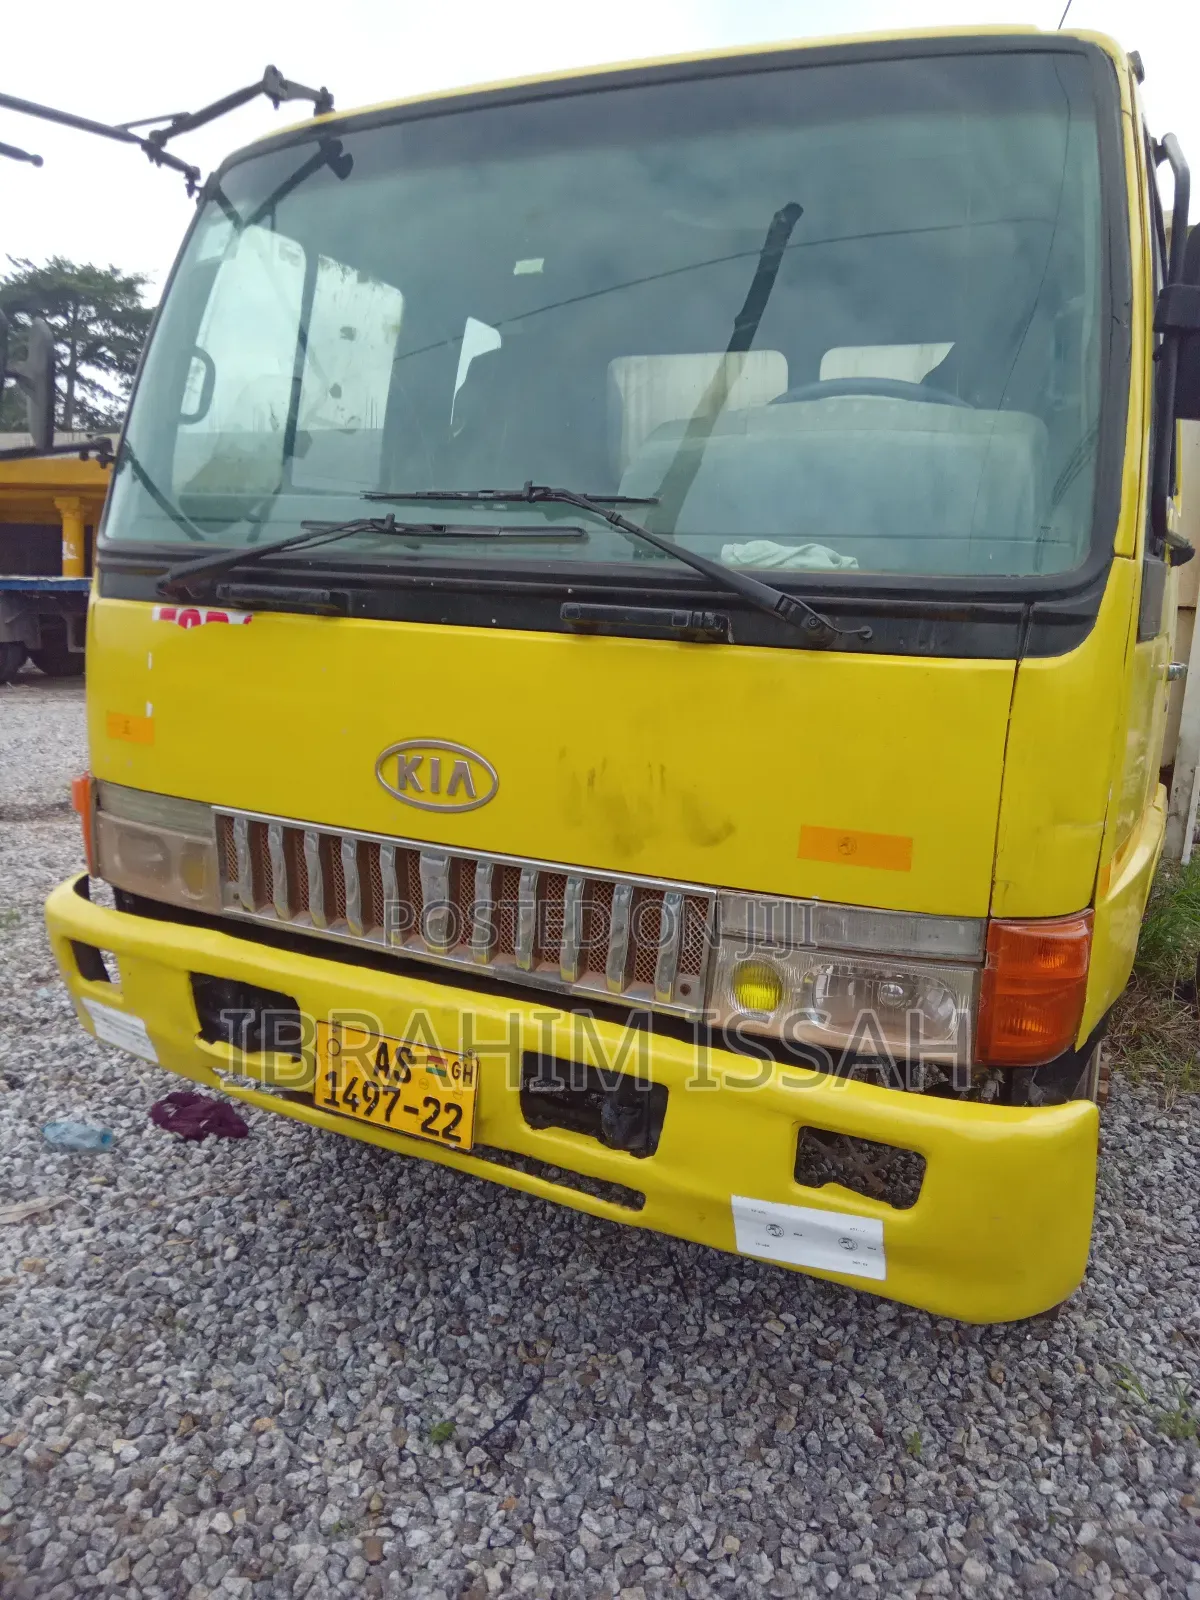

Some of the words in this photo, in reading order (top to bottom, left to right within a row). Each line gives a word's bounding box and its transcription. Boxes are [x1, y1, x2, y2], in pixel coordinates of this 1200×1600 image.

[397, 754, 476, 798] KIA
[373, 1041, 417, 1084] AS
[451, 1061, 474, 1084] GH
[323, 1071, 463, 1143] 1497-22
